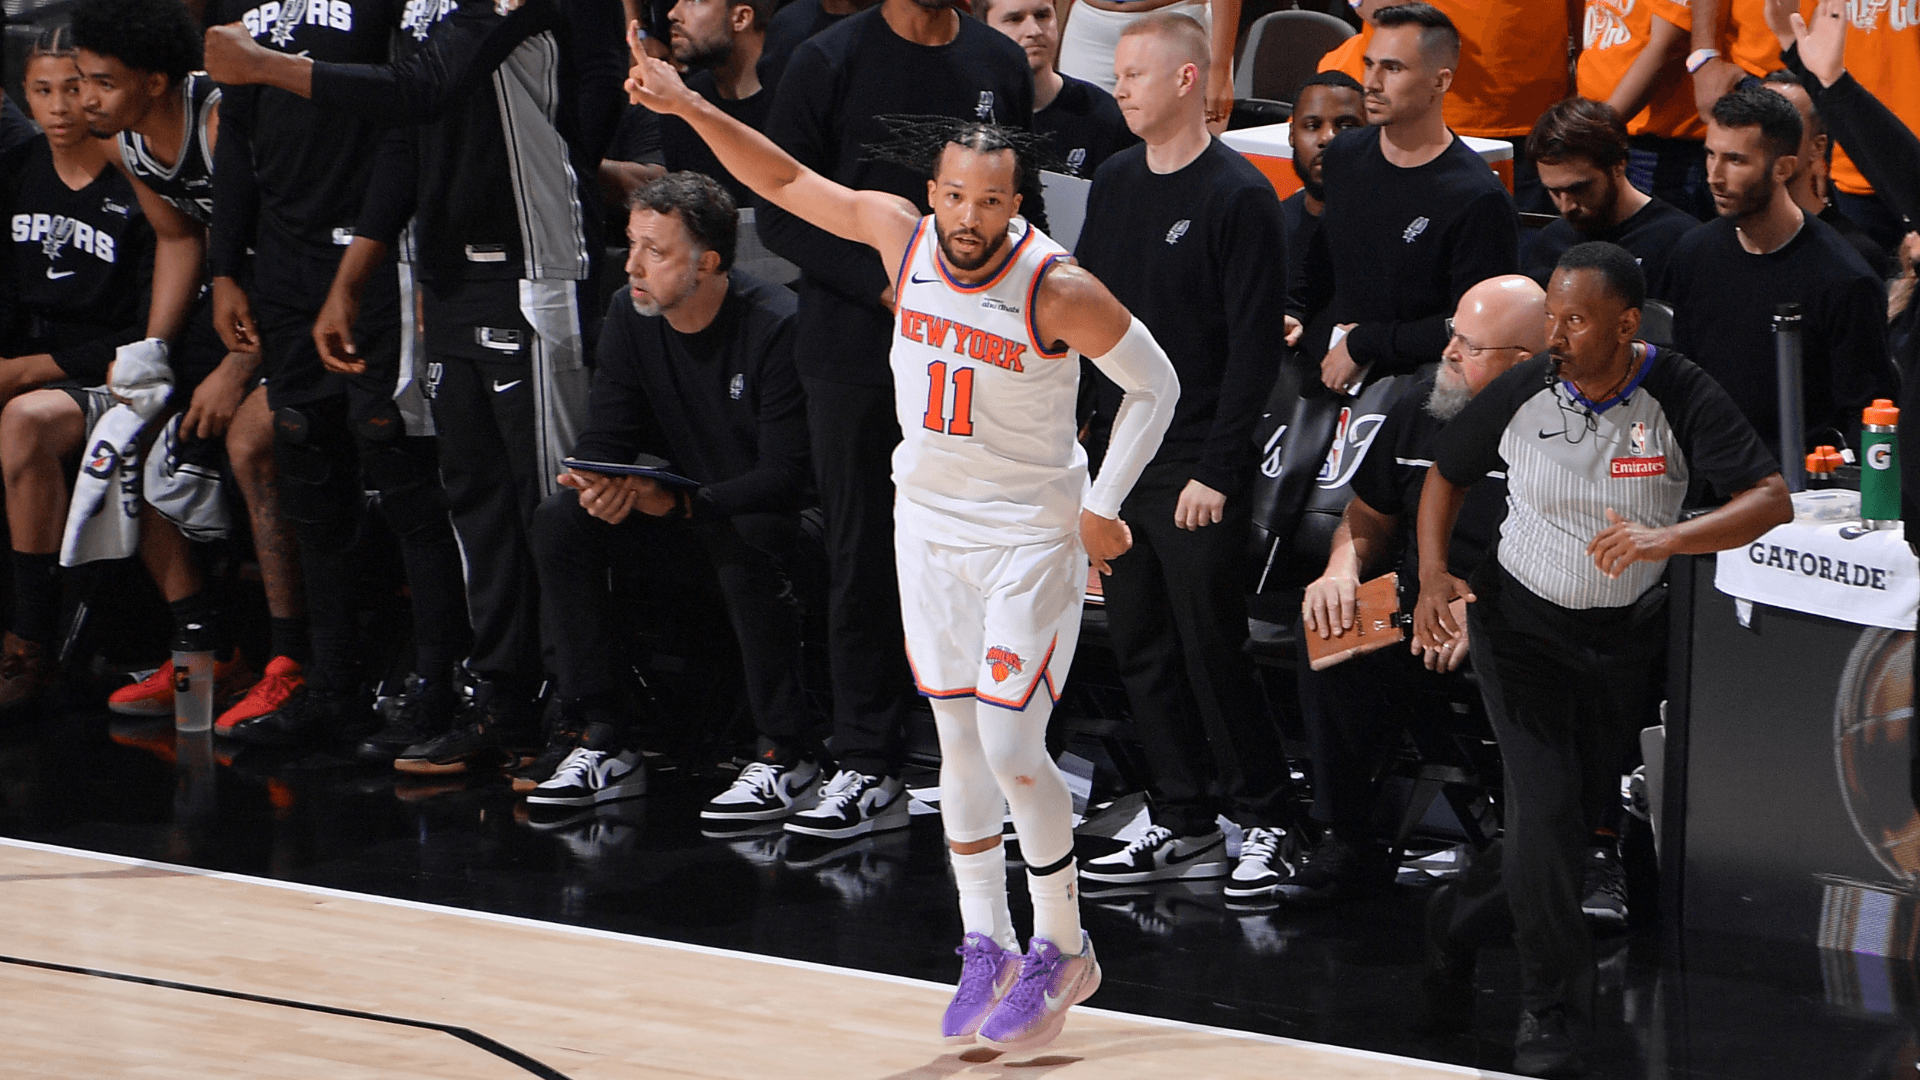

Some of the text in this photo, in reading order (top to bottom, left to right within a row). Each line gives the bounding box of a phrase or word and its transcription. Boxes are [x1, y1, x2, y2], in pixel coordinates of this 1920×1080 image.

[12, 213, 115, 263] SPURS
[901, 307, 1027, 373] NEW YORK
[923, 360, 975, 437] 11
[1612, 461, 1665, 474] Emirates
[1865, 443, 1892, 471] G
[1749, 542, 1887, 591] GATORADE
